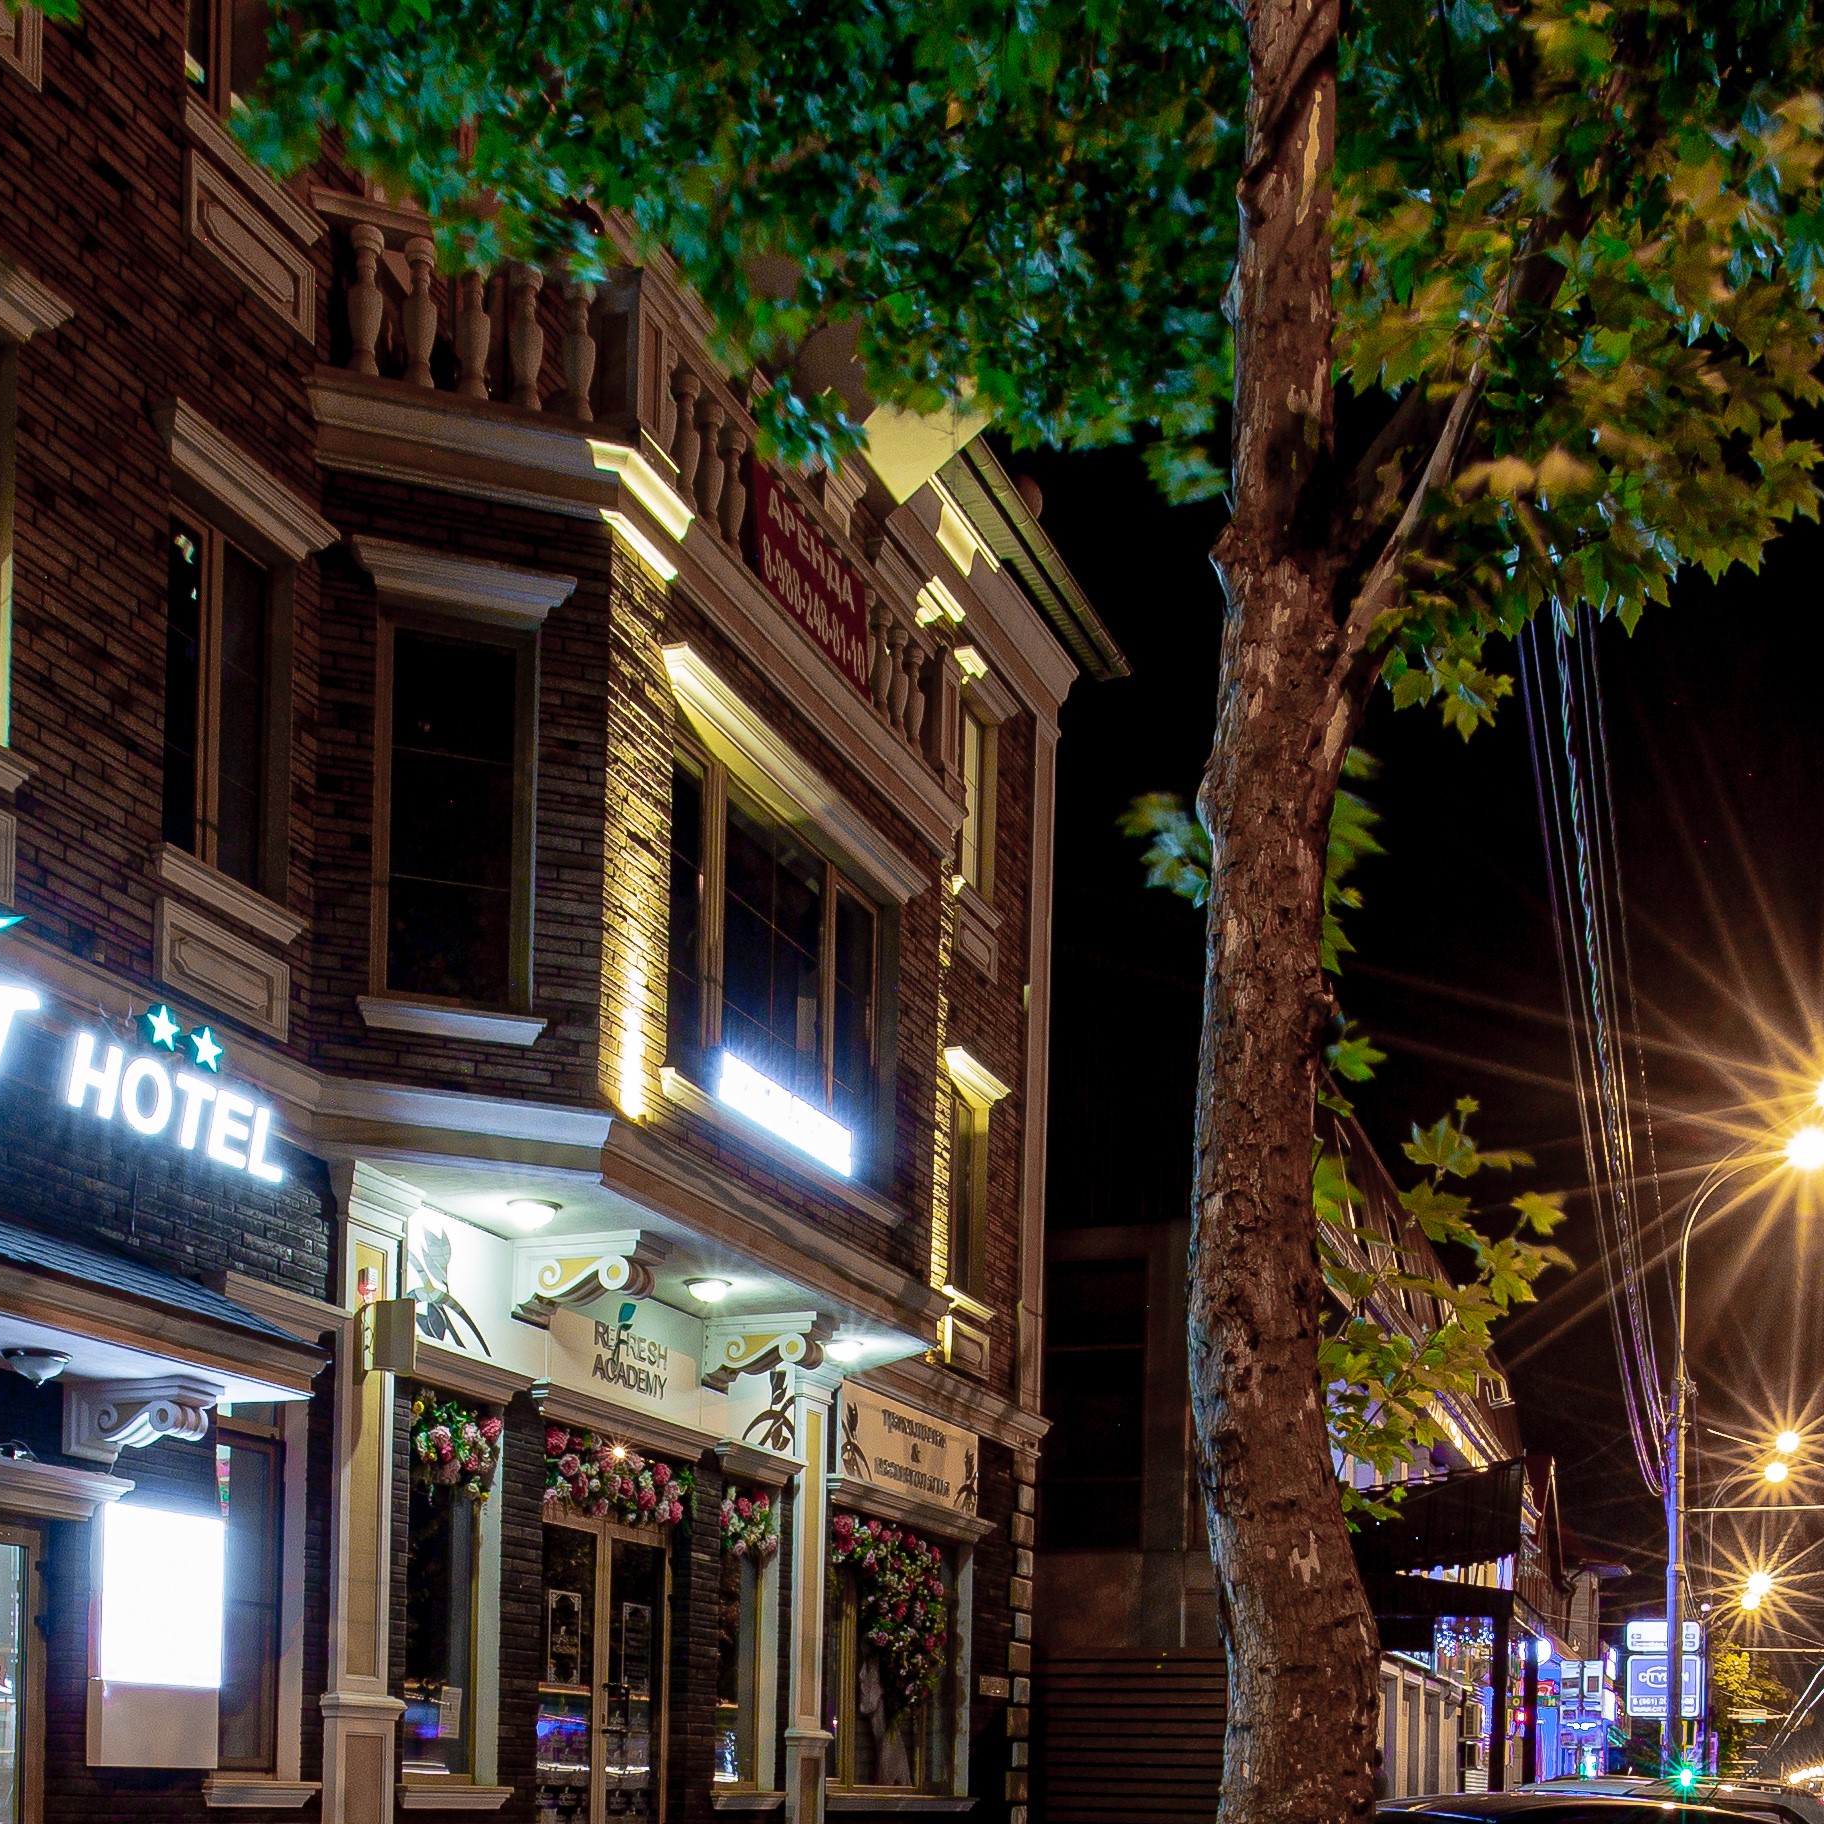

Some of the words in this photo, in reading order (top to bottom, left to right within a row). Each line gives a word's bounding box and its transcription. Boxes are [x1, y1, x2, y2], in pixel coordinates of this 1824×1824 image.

[762, 533, 866, 686] 8-988-248-81-10
[768, 487, 856, 614] АРЕНДА
[67, 1030, 283, 1183] HOTEL
[591, 1353, 668, 1401] ACADEMY
[593, 1318, 669, 1371] REFRESH
